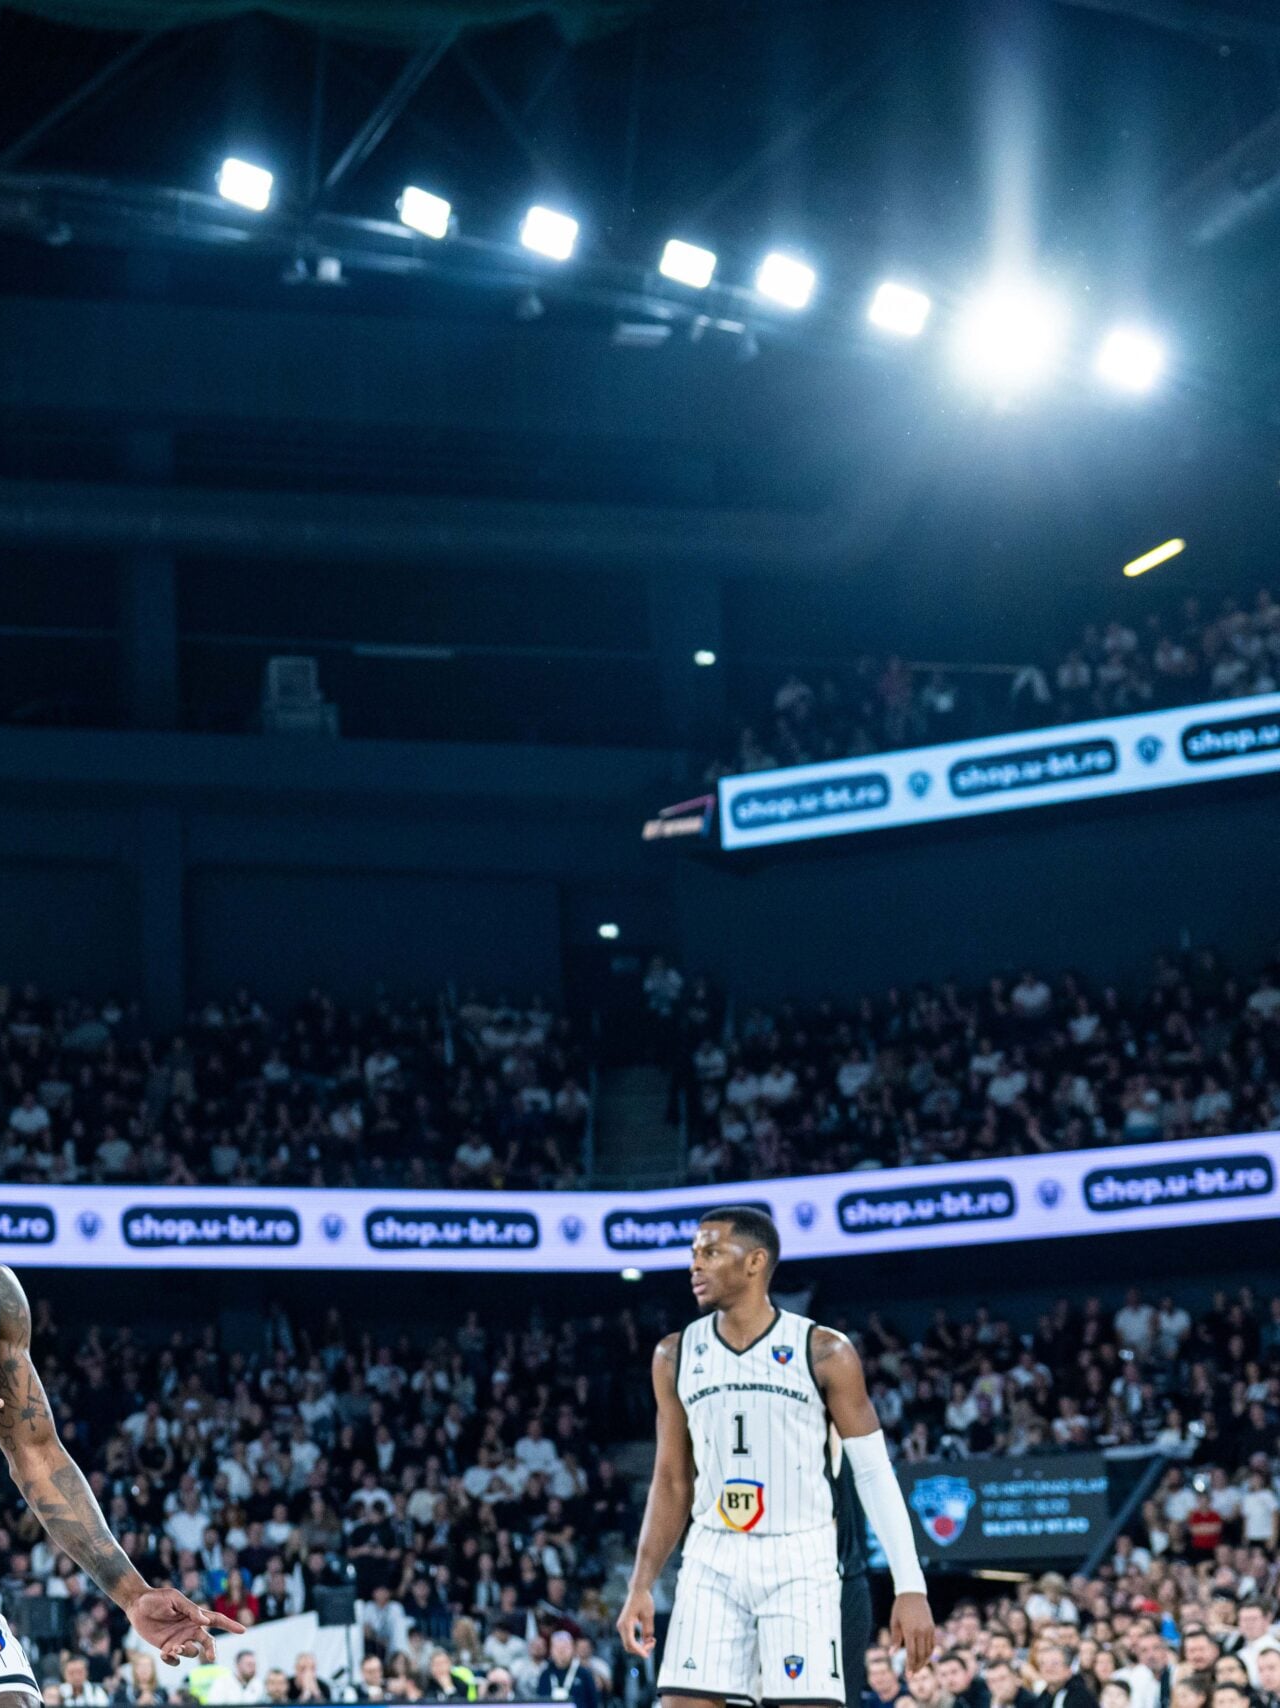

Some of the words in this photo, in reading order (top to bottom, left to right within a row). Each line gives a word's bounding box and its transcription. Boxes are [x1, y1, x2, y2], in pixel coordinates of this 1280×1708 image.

[1089, 1167, 1268, 1205] shop.u-bt.ro
[843, 1192, 1010, 1228] shop.u-bt.ro
[128, 1215, 295, 1245] shop.u-bt.ro
[371, 1217, 534, 1247] shop.u-bt.ro
[731, 1411, 752, 1457] 1
[726, 1492, 754, 1510] BT
[830, 1639, 841, 1680] 1
